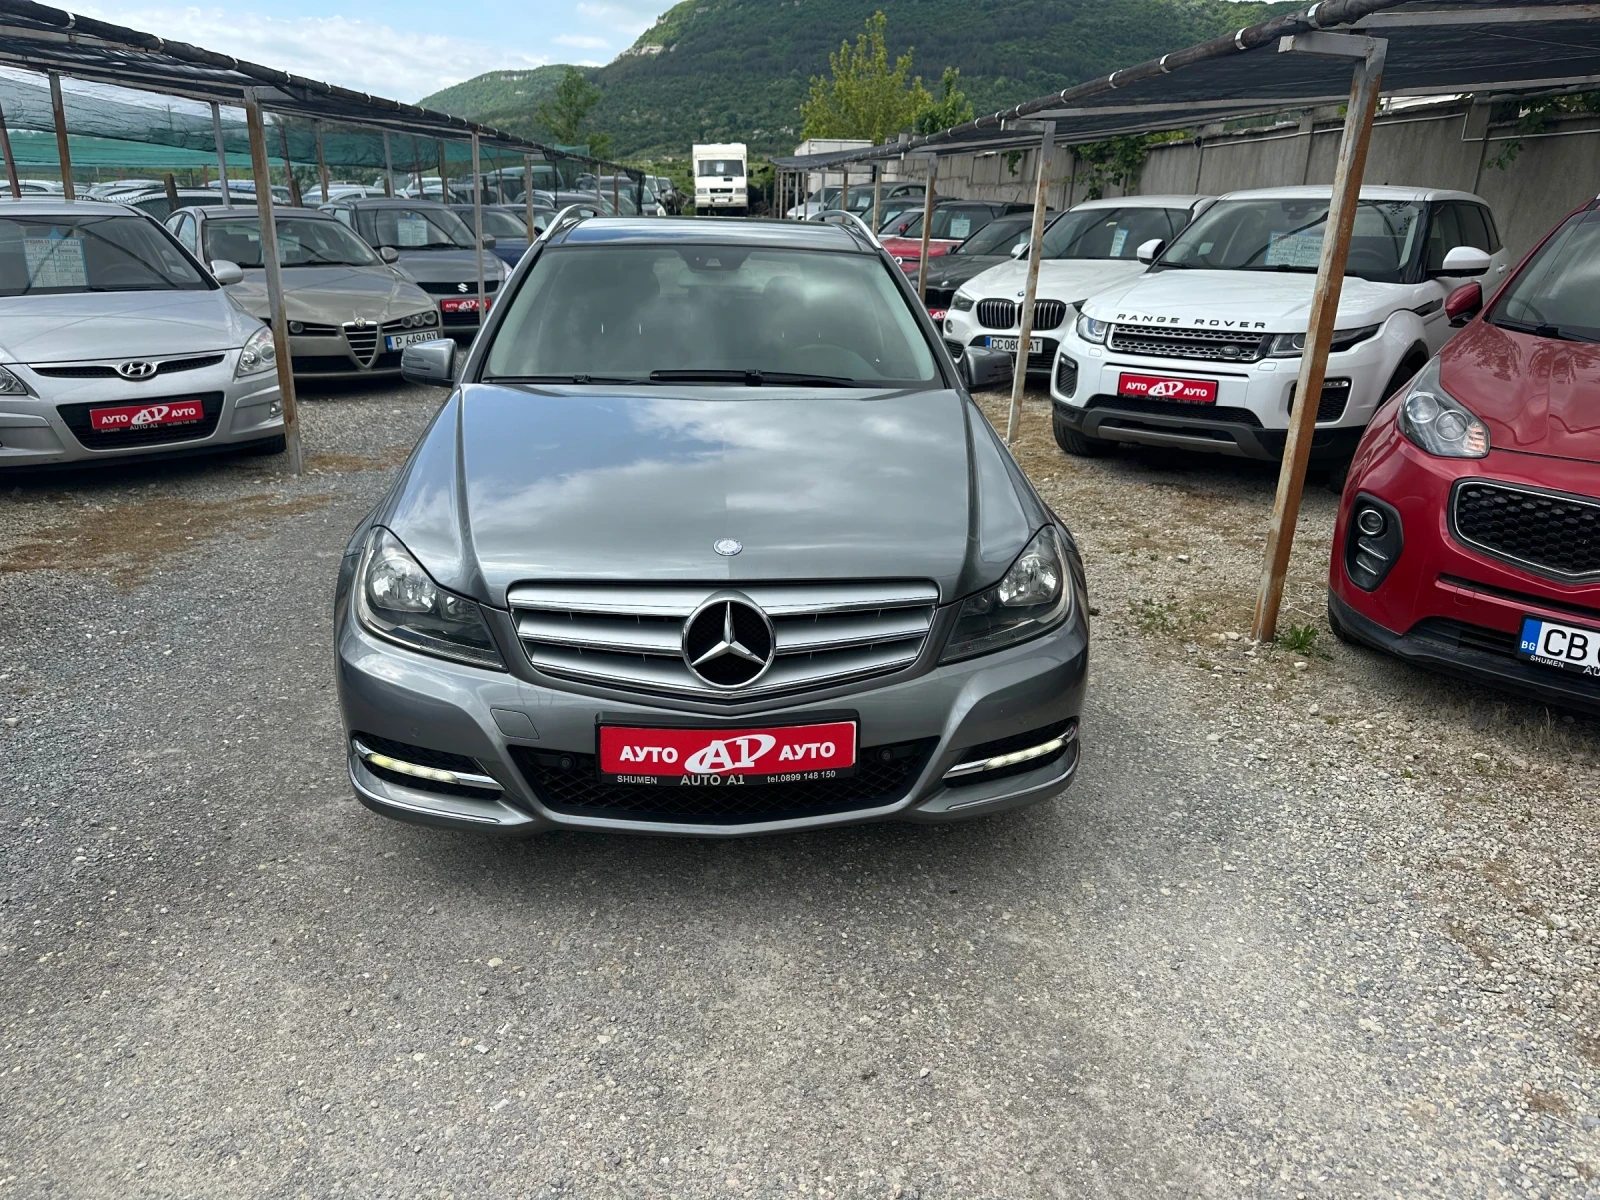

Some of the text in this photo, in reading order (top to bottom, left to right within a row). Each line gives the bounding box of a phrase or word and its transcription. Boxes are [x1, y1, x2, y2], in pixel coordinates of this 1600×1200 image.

[1117, 313, 1266, 329] RANGE ROVER
[1126, 382, 1147, 391] АУТО
[1183, 388, 1208, 397] АУТО
[101, 414, 129, 425] АУТО
[171, 407, 197, 418] АУТО
[1521, 640, 1536, 651] BG
[1543, 628, 1589, 662] CB
[1530, 654, 1565, 668] SHUMEN
[619, 745, 679, 763] АУТО
[778, 741, 836, 762] АУТО
[617, 770, 836, 786] SHUMEN AUTO A1 tel.0899 148 150
